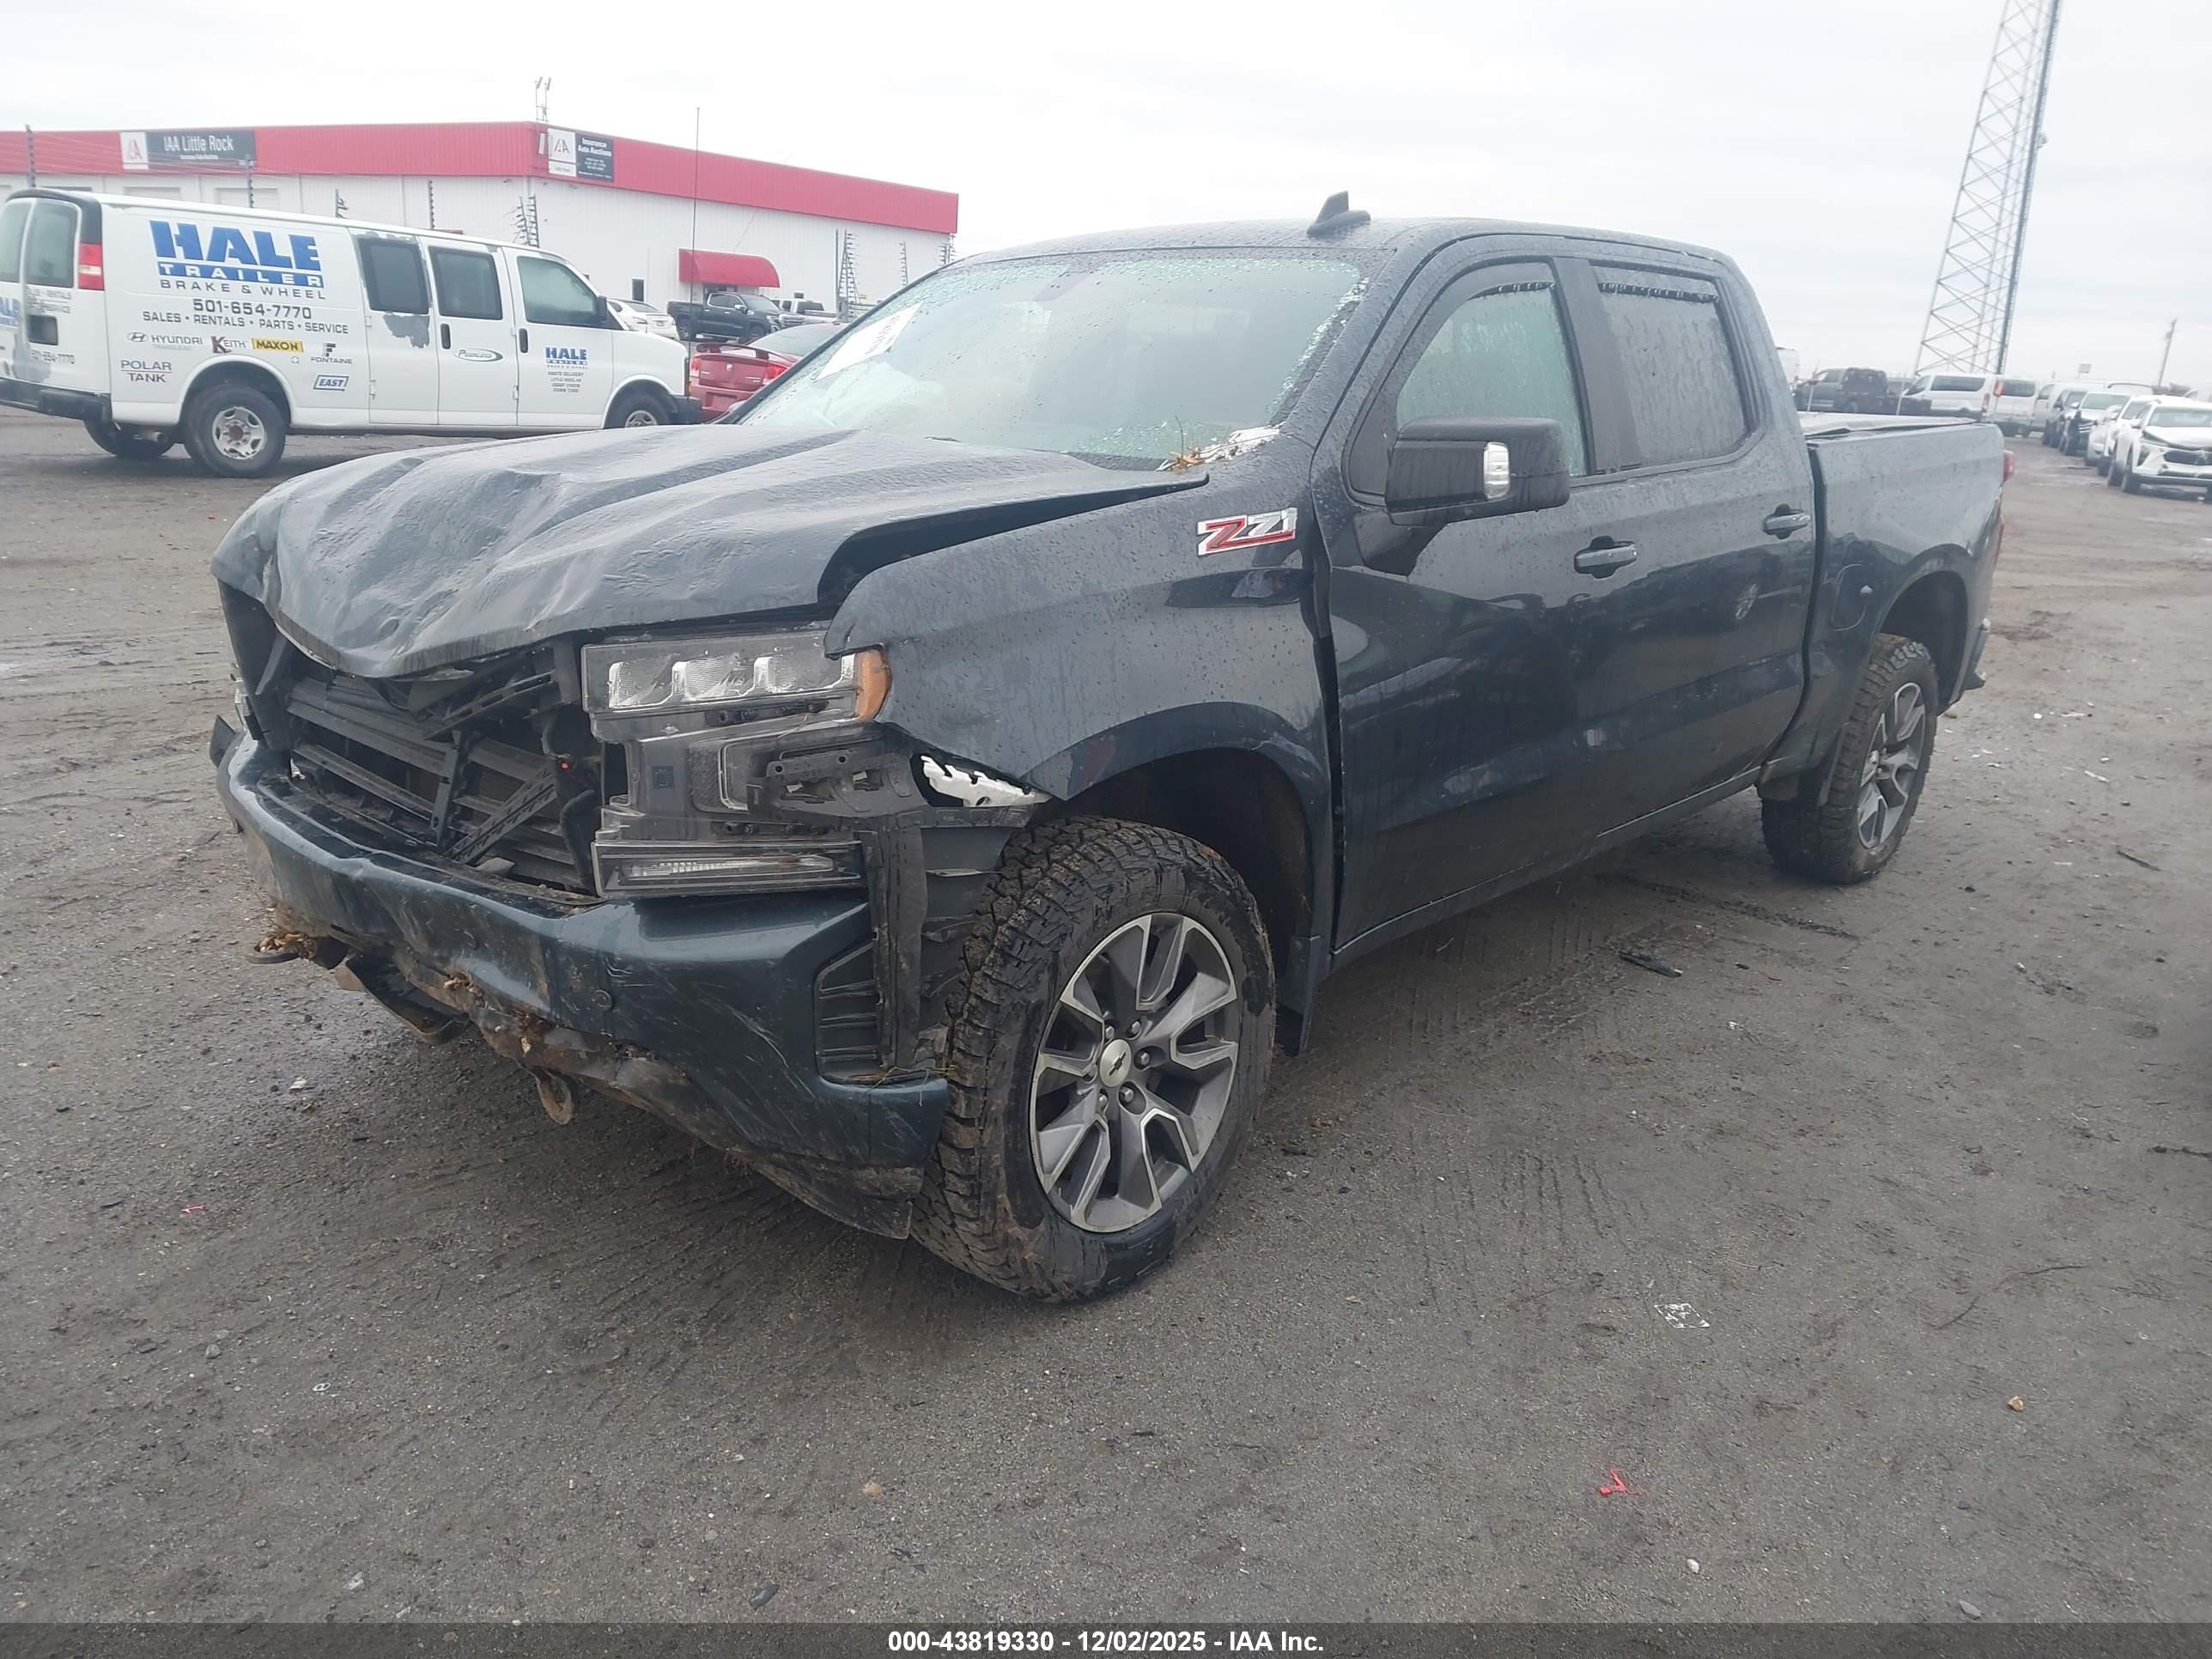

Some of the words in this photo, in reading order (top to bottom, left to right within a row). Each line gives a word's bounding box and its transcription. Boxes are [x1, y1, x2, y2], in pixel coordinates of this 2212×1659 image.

[181, 136, 207, 151] Little
[209, 135, 234, 151] Rock
[149, 220, 321, 271] HALE
[161, 264, 323, 288] TRAILER
[161, 279, 230, 292] BRAKE
[241, 284, 252, 294] &
[260, 286, 326, 300] WHEEL
[193, 299, 312, 319] 501-654-7770
[143, 311, 181, 323] SALES
[194, 314, 245, 327] RENTALS
[259, 319, 294, 331] PARTS
[305, 322, 349, 334] SERVICE
[151, 335, 204, 345] HYUNDAI
[210, 336, 246, 354] KEITH
[256, 341, 299, 351] MAXON
[545, 347, 587, 360] HALE
[121, 360, 172, 371] POLAR
[127, 373, 166, 383] TANK
[319, 379, 344, 387] EAST
[1197, 507, 1297, 556] Z71
